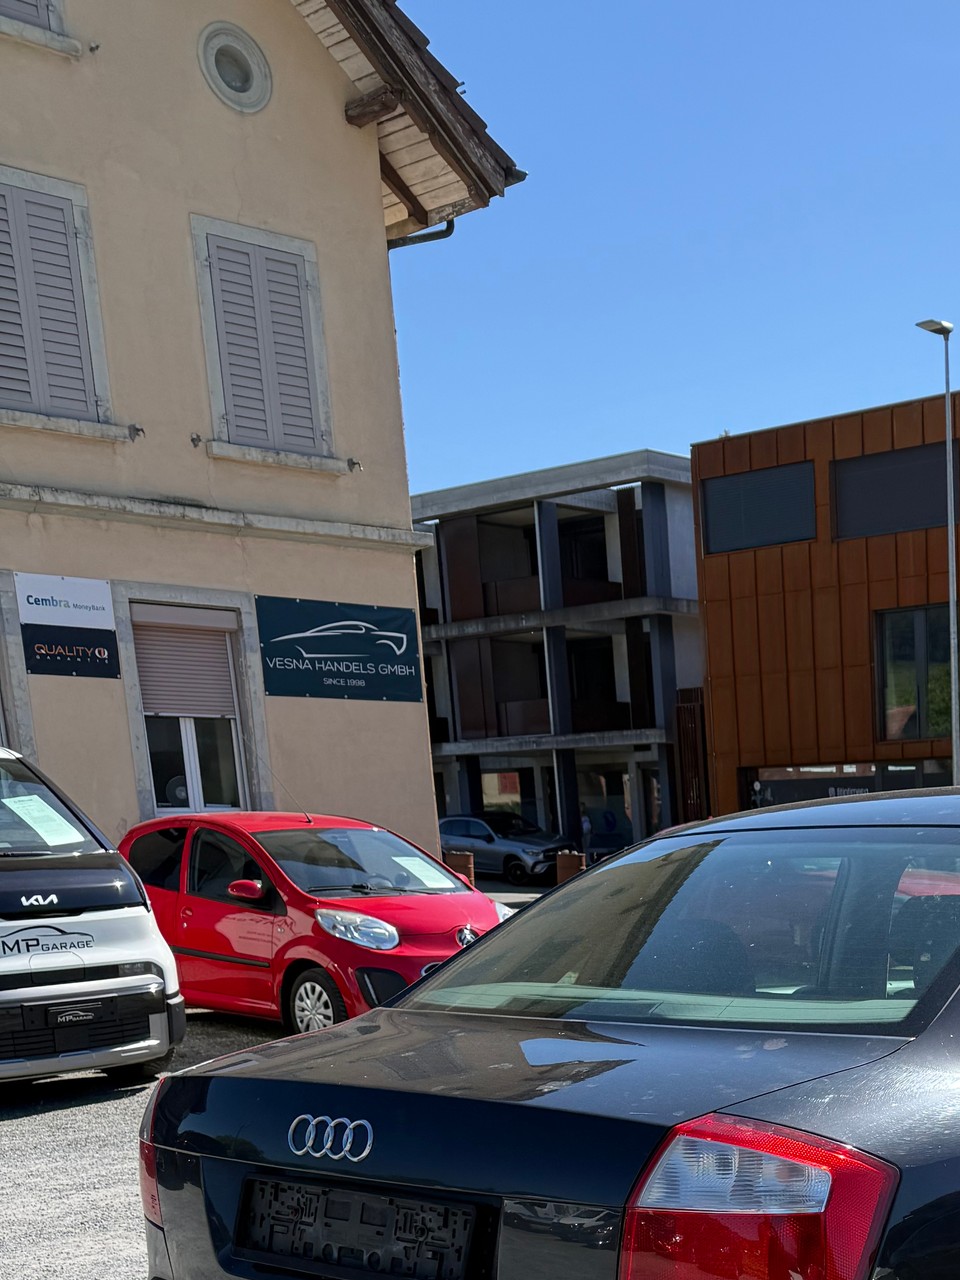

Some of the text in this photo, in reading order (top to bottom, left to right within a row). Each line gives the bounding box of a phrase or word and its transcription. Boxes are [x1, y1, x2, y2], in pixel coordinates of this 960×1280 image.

[26, 594, 106, 612] Cembra MoneyBank
[34, 643, 94, 657] QUALITY
[265, 657, 415, 677] VESNA HANDELS GMBH
[323, 677, 366, 687] SINCE 1998
[20, 894, 58, 906] KIA
[1, 938, 94, 955] MP GARAGE
